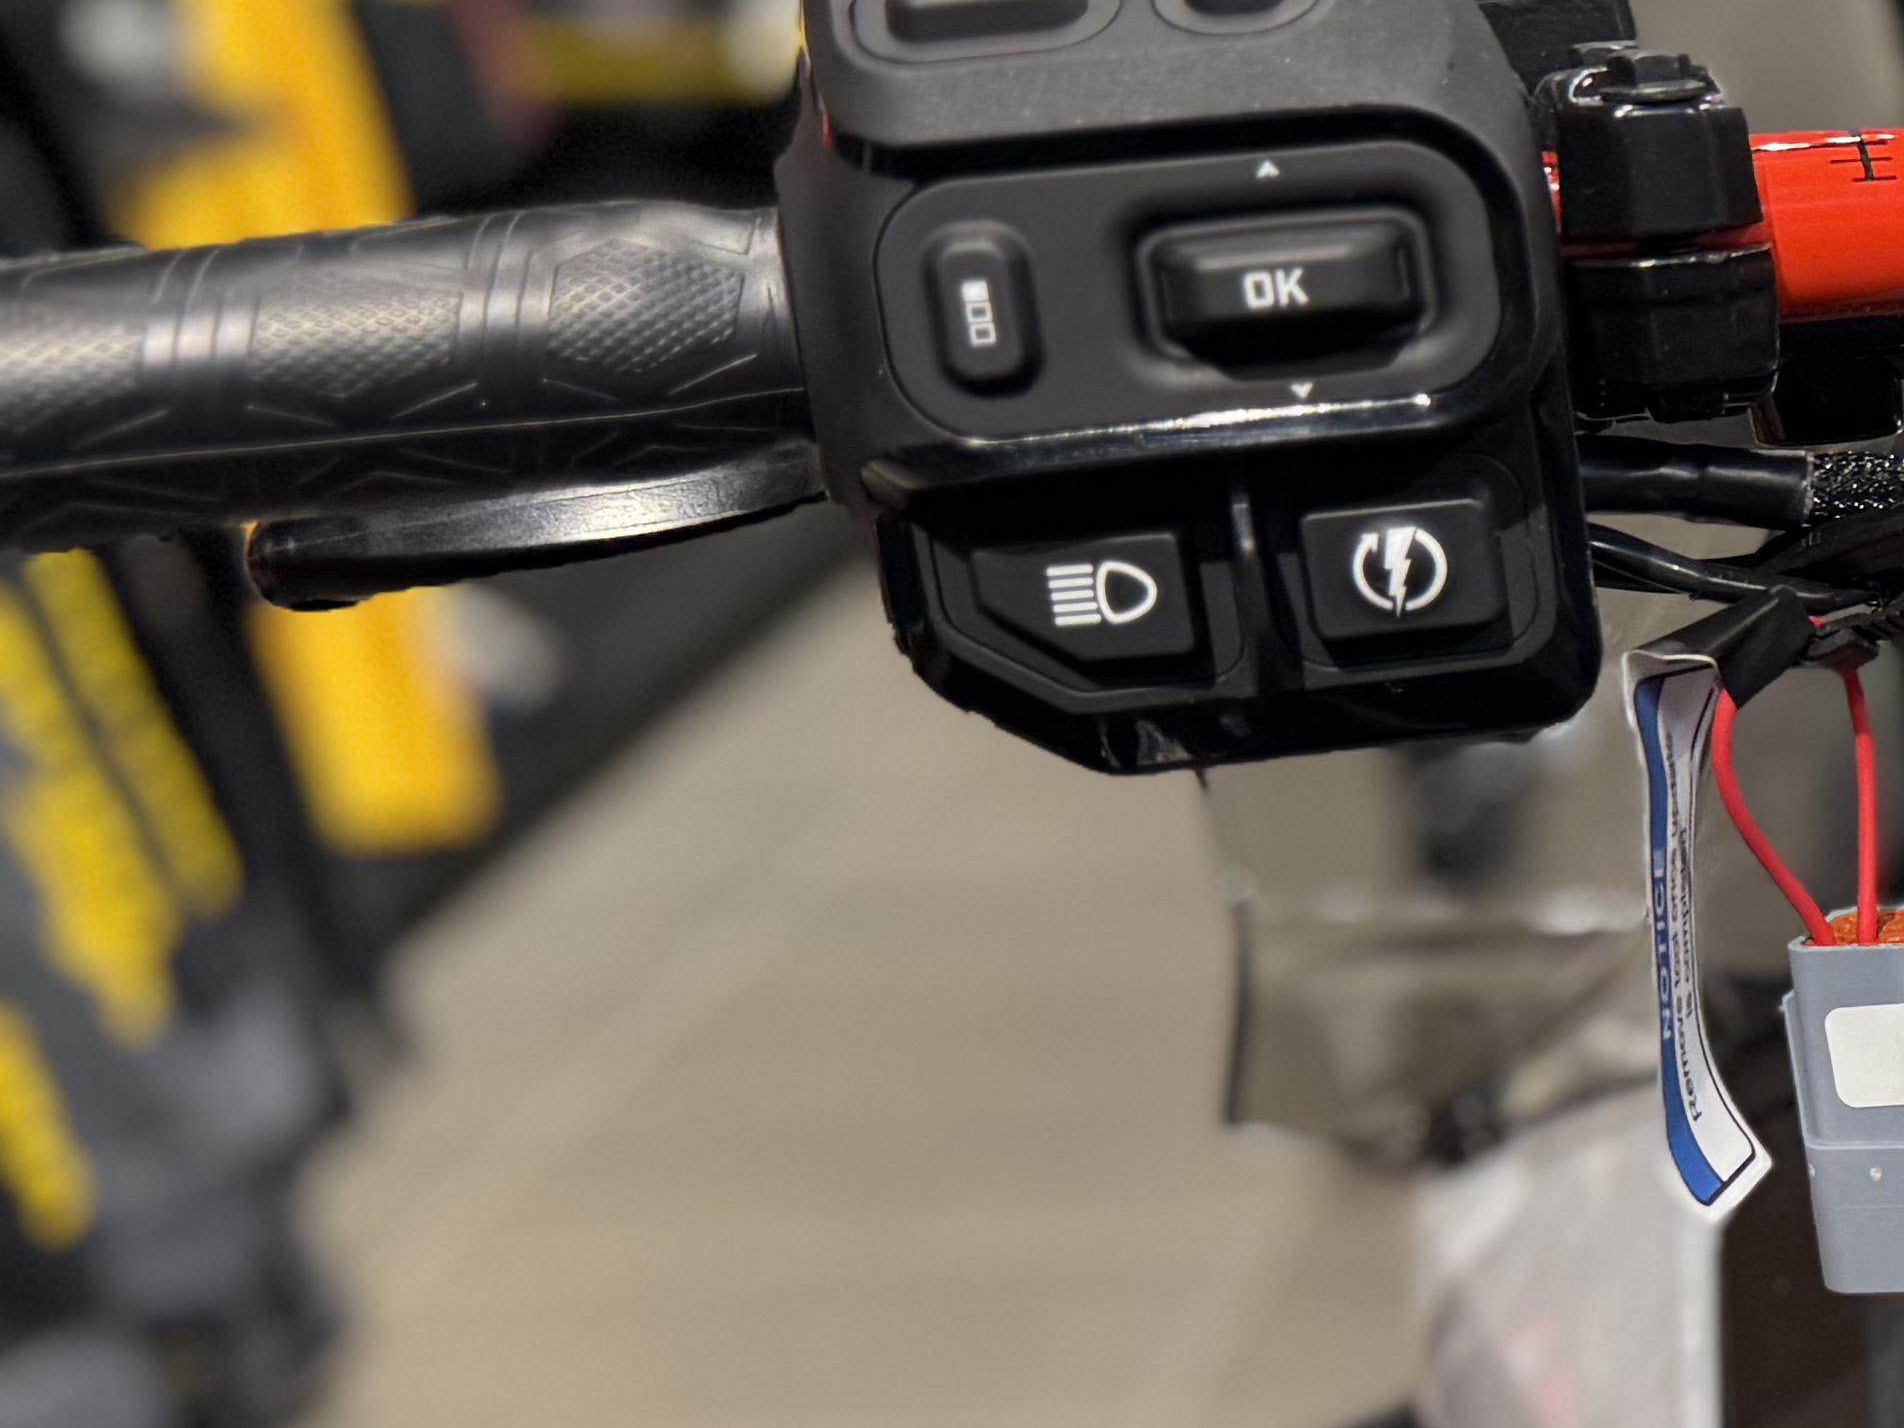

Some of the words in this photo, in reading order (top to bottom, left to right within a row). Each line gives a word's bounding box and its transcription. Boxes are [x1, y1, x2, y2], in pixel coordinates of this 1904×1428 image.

[1243, 267, 1310, 310] OK
[1653, 848, 1672, 1040] NOTICE
[1671, 932, 1682, 988] tool
[1674, 995, 1702, 1122] Remove
